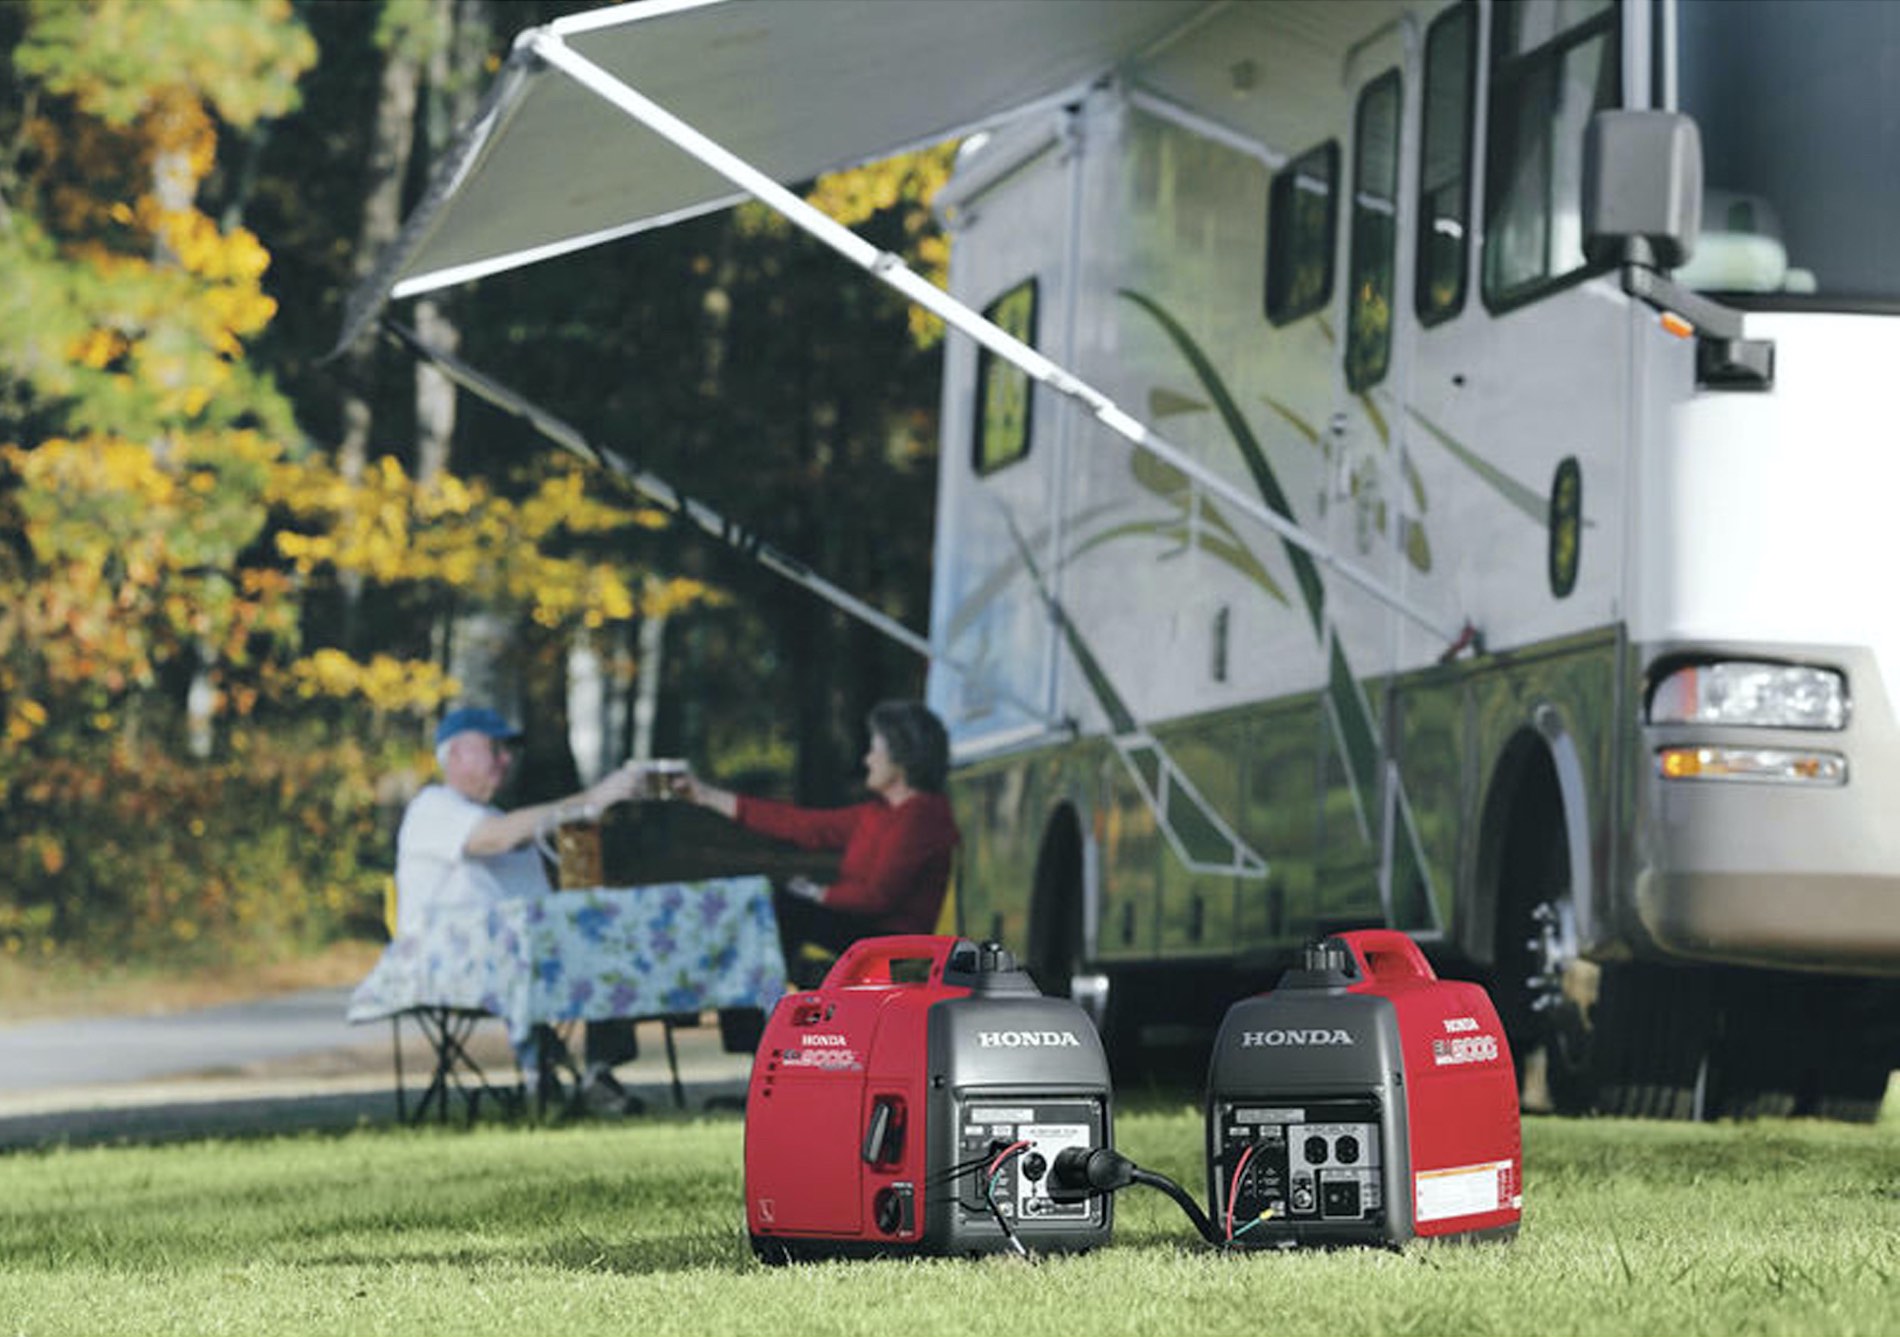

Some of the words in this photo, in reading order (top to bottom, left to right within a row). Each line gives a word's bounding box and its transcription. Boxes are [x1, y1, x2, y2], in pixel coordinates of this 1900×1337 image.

[1443, 1018, 1480, 1033] HONDA
[802, 1034, 847, 1046] HONDA
[978, 1031, 1081, 1047] HONDA
[1241, 1030, 1354, 1048] HONDA
